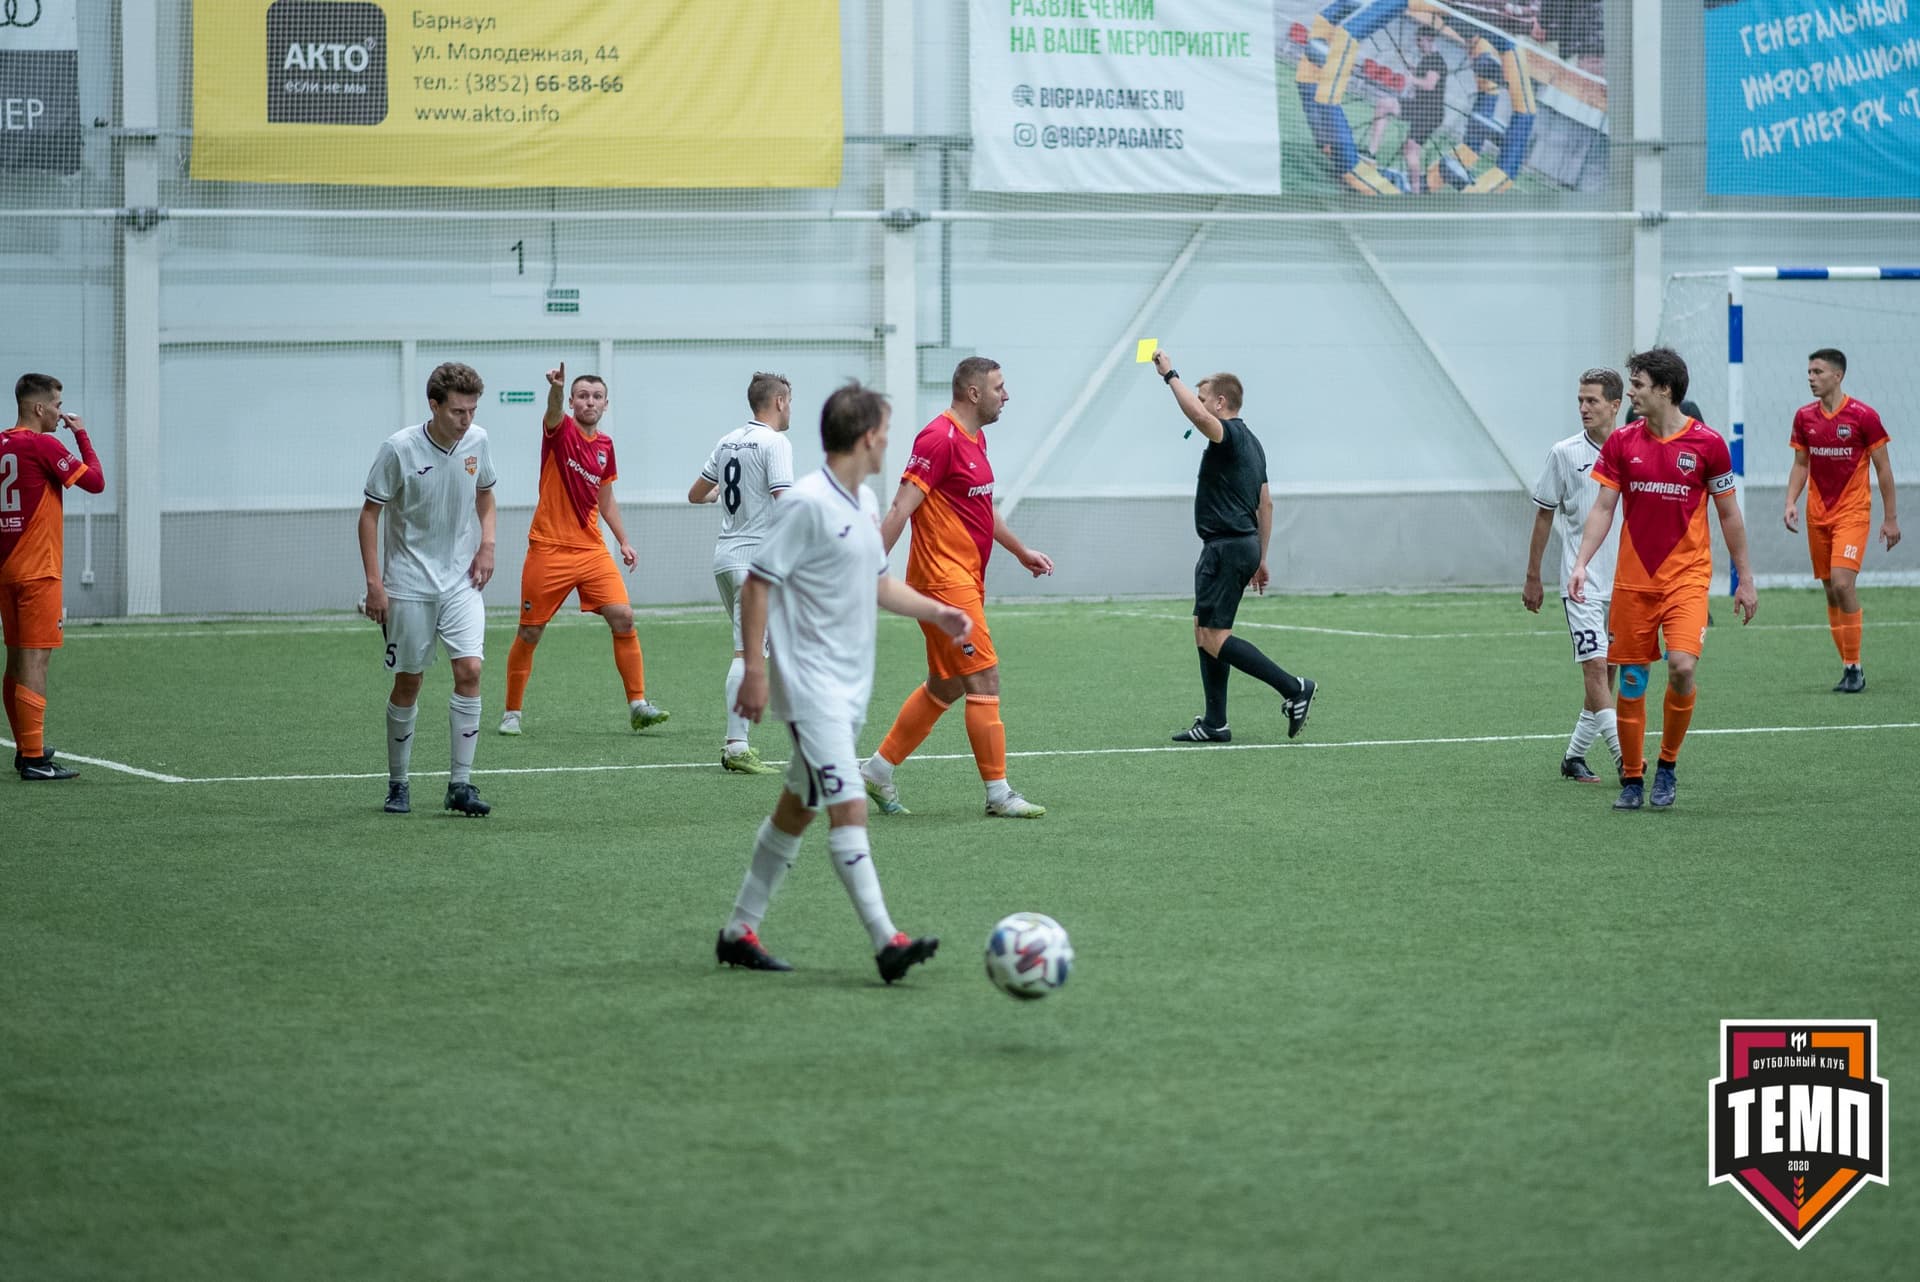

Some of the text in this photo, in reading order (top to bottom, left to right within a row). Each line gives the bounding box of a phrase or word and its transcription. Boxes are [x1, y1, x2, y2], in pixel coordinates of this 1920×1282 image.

[412, 10, 497, 34] Барнаул
[412, 43, 620, 64] ул. Молодежная, 44
[1010, 27, 1250, 57] НА ВАШЕ МЕРОПРИЯТИЕ
[285, 81, 367, 93] если не мы
[414, 73, 624, 94] тел.: (3852) 66-88-66
[1040, 87, 1184, 110] BIGPAPAGAMES.RU
[0, 98, 44, 130] ЕР
[415, 104, 560, 122] www.akto.info
[1042, 126, 1184, 150] @BIGPAPAGAMES
[1740, 106, 1846, 160] ПАРТНЕР
[1852, 94, 1893, 132] ФК
[511, 240, 524, 275] 1
[724, 457, 741, 515] 8
[1574, 629, 1598, 656] 23
[385, 643, 398, 668] 5
